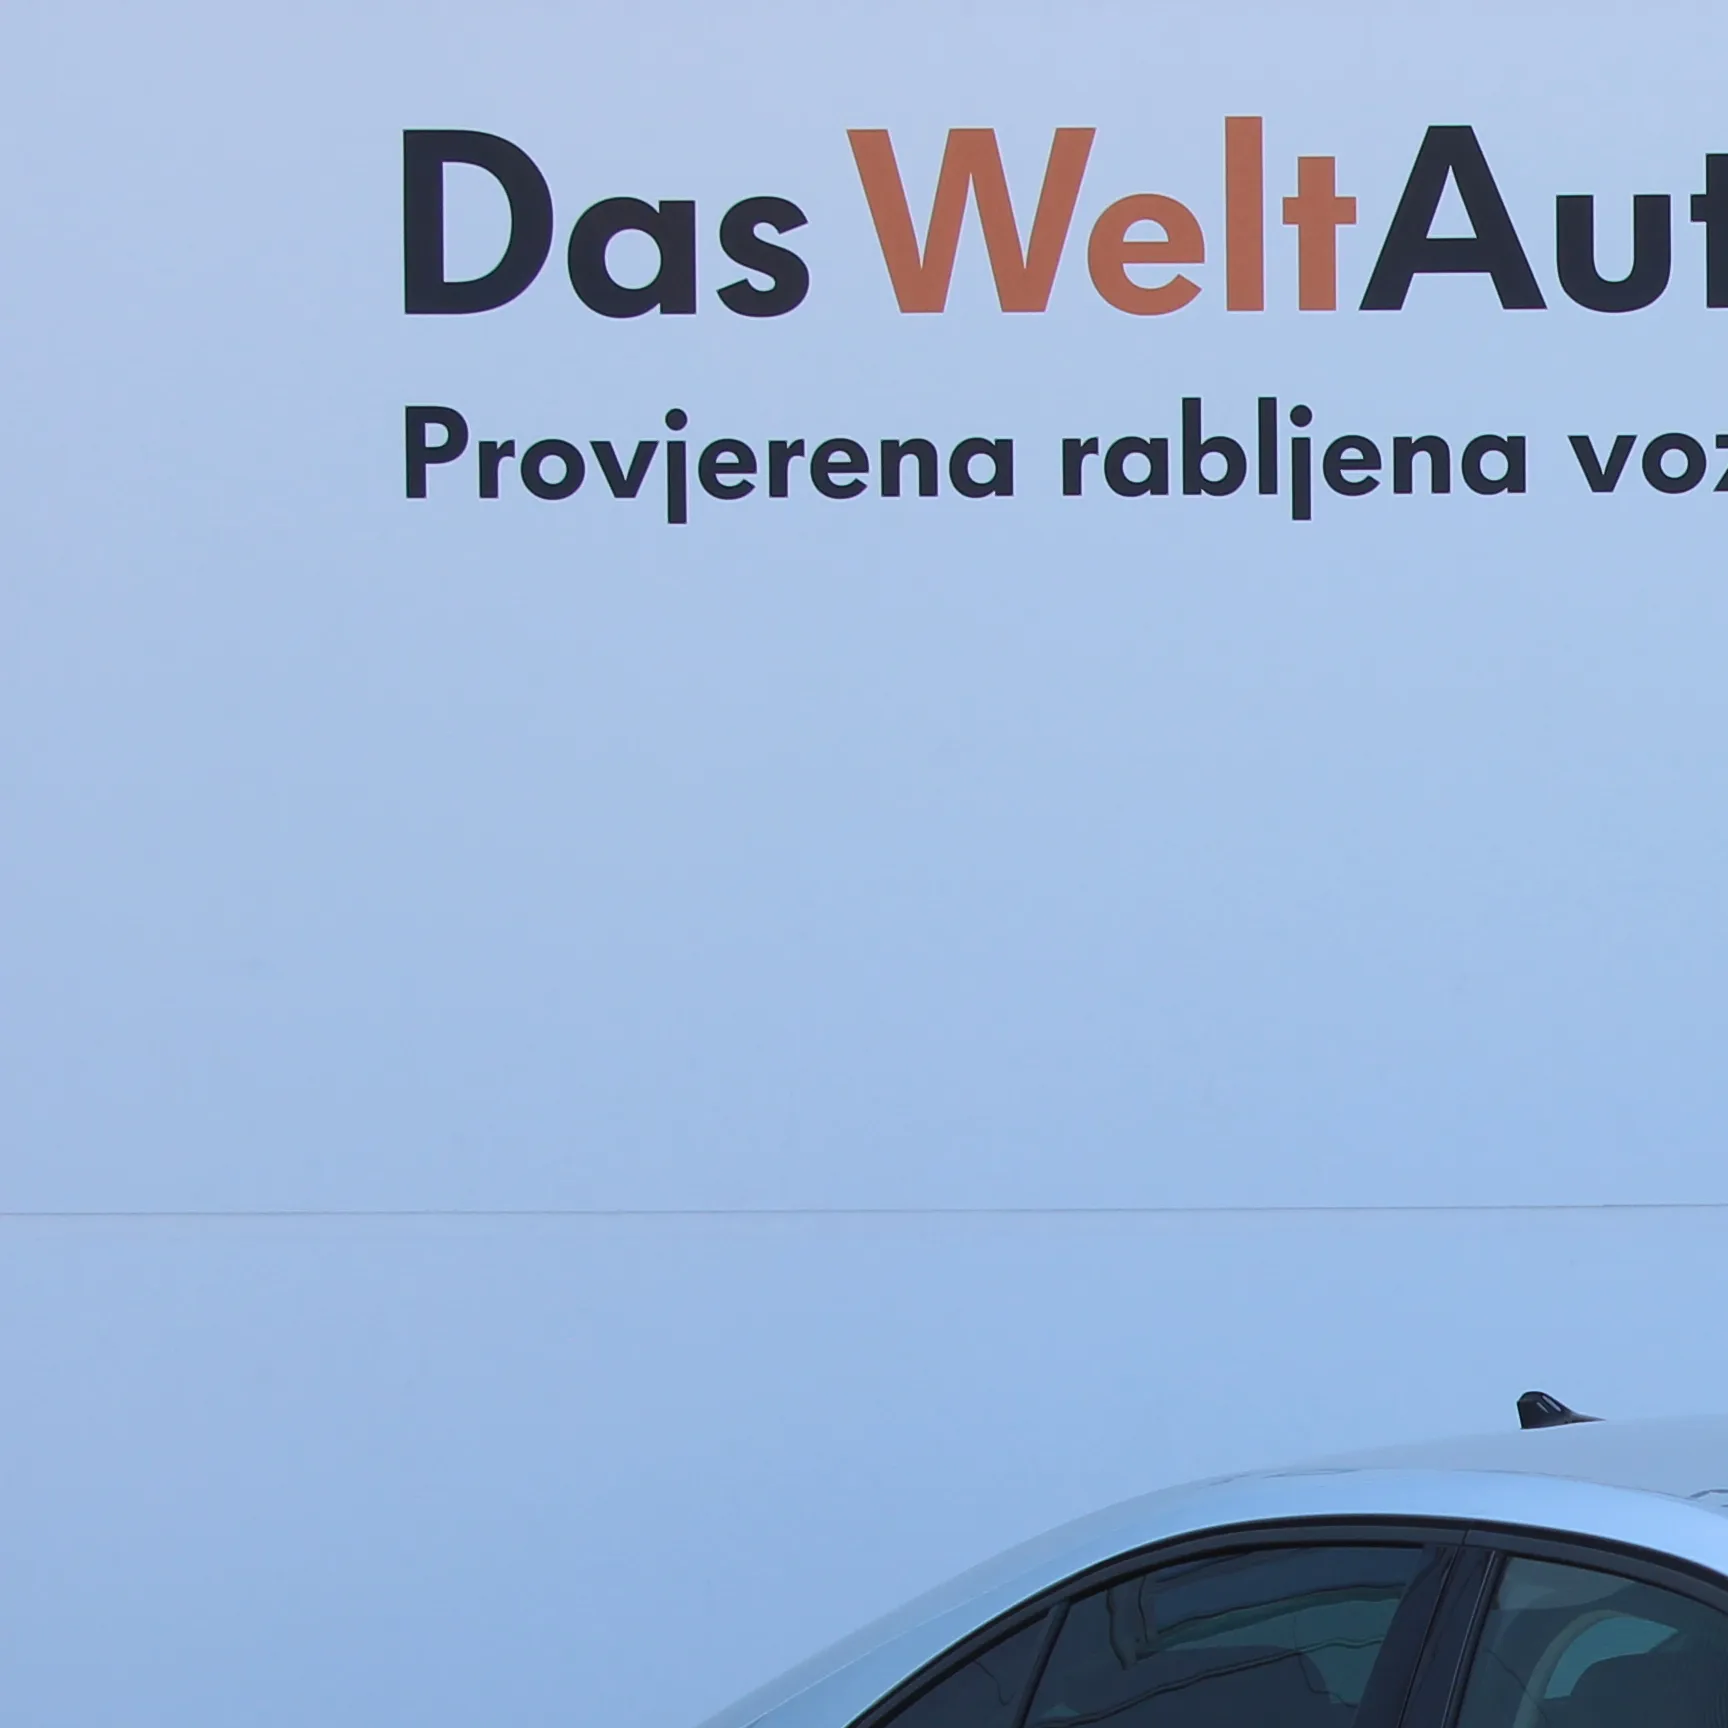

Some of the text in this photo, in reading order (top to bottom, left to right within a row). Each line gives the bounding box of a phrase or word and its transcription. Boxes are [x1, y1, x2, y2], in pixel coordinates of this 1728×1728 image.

[403, 129, 809, 318] Das
[405, 406, 1013, 524] Provjerena
[1062, 396, 1525, 520] rabljena
